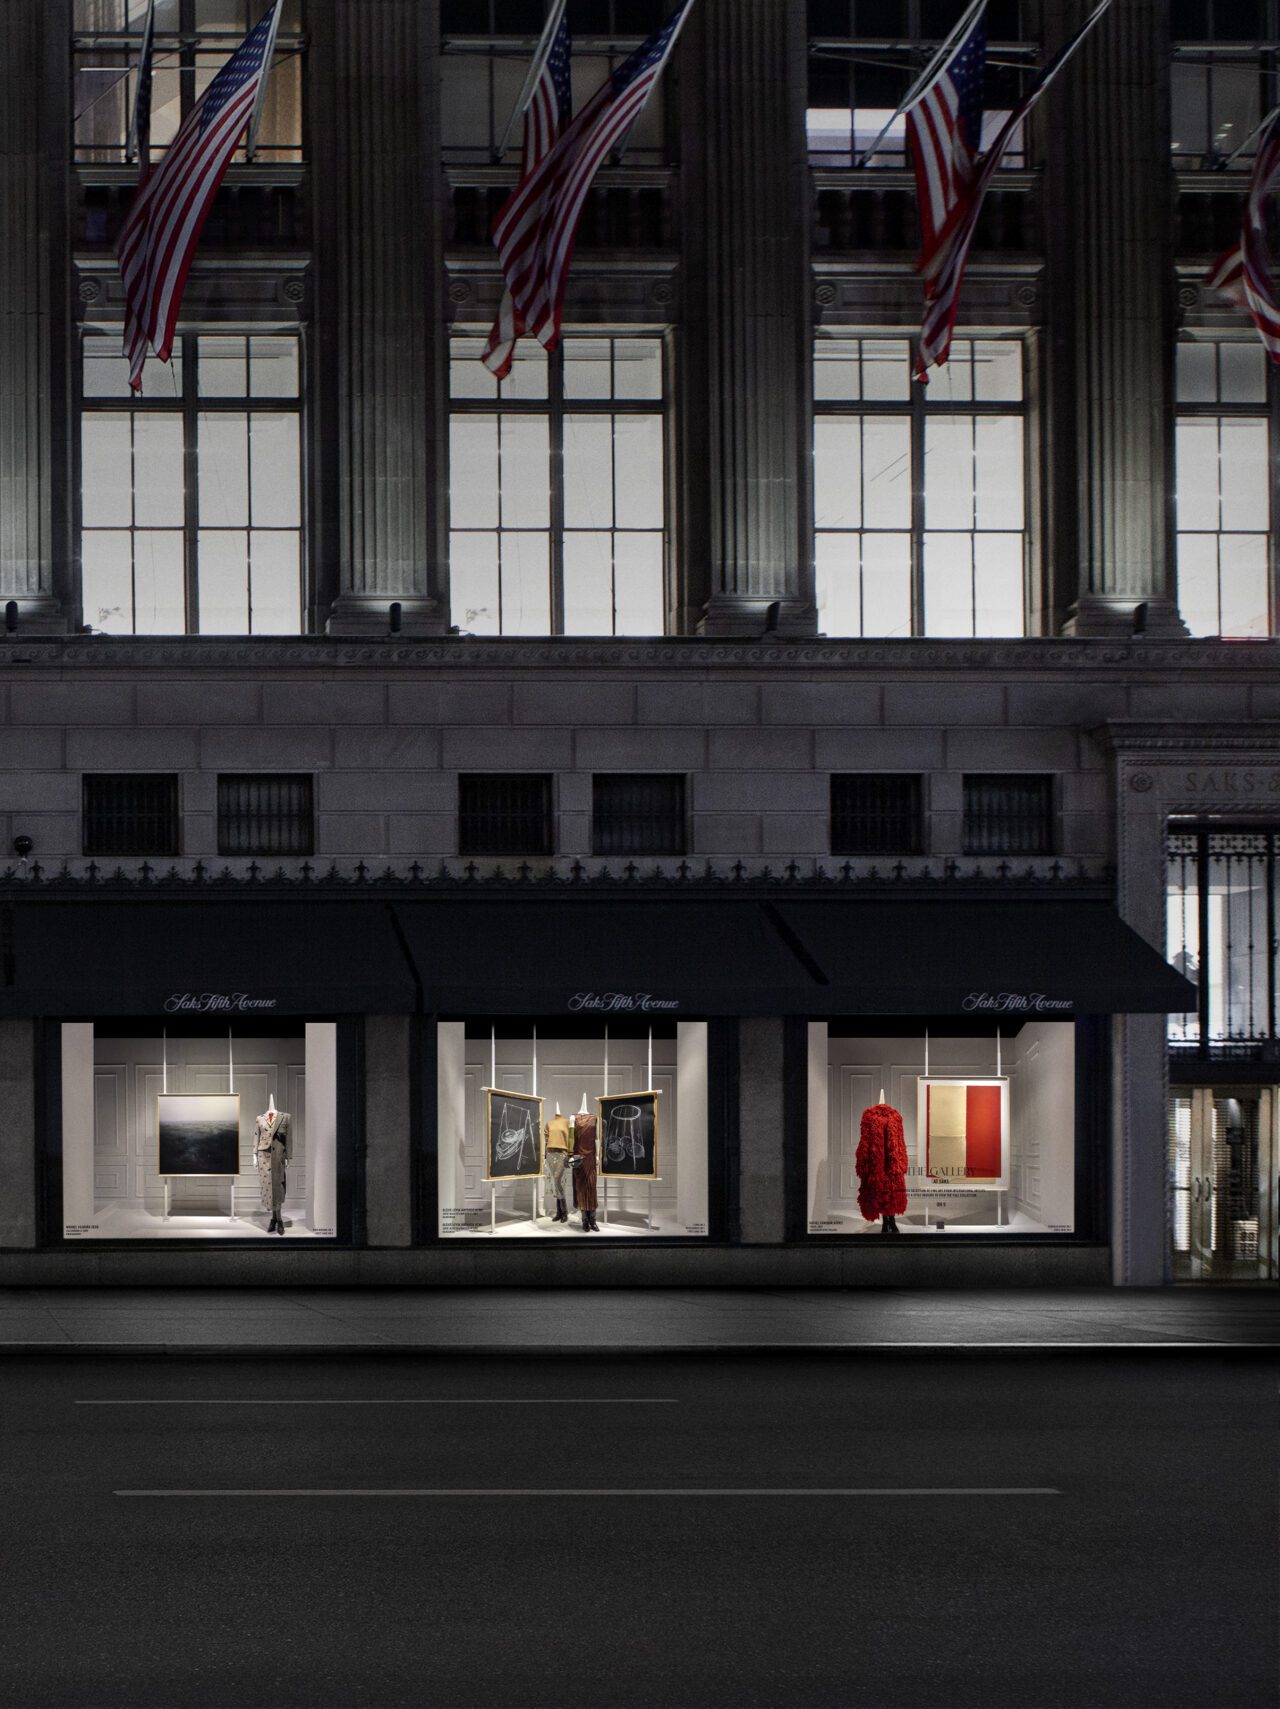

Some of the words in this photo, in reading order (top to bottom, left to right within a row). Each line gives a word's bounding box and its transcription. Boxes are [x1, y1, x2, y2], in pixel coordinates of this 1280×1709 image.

[1184, 772, 1255, 793] SAKS
[163, 993, 201, 1012] Saks
[197, 993, 230, 1012] Fifth
[223, 992, 277, 1011] Avenue
[568, 993, 605, 1011] Saks
[600, 993, 634, 1011] Fifth
[627, 993, 679, 1011] Avenue
[962, 993, 999, 1011] Saks
[993, 993, 1028, 1011] Fifth
[1021, 993, 1074, 1011] Avenue
